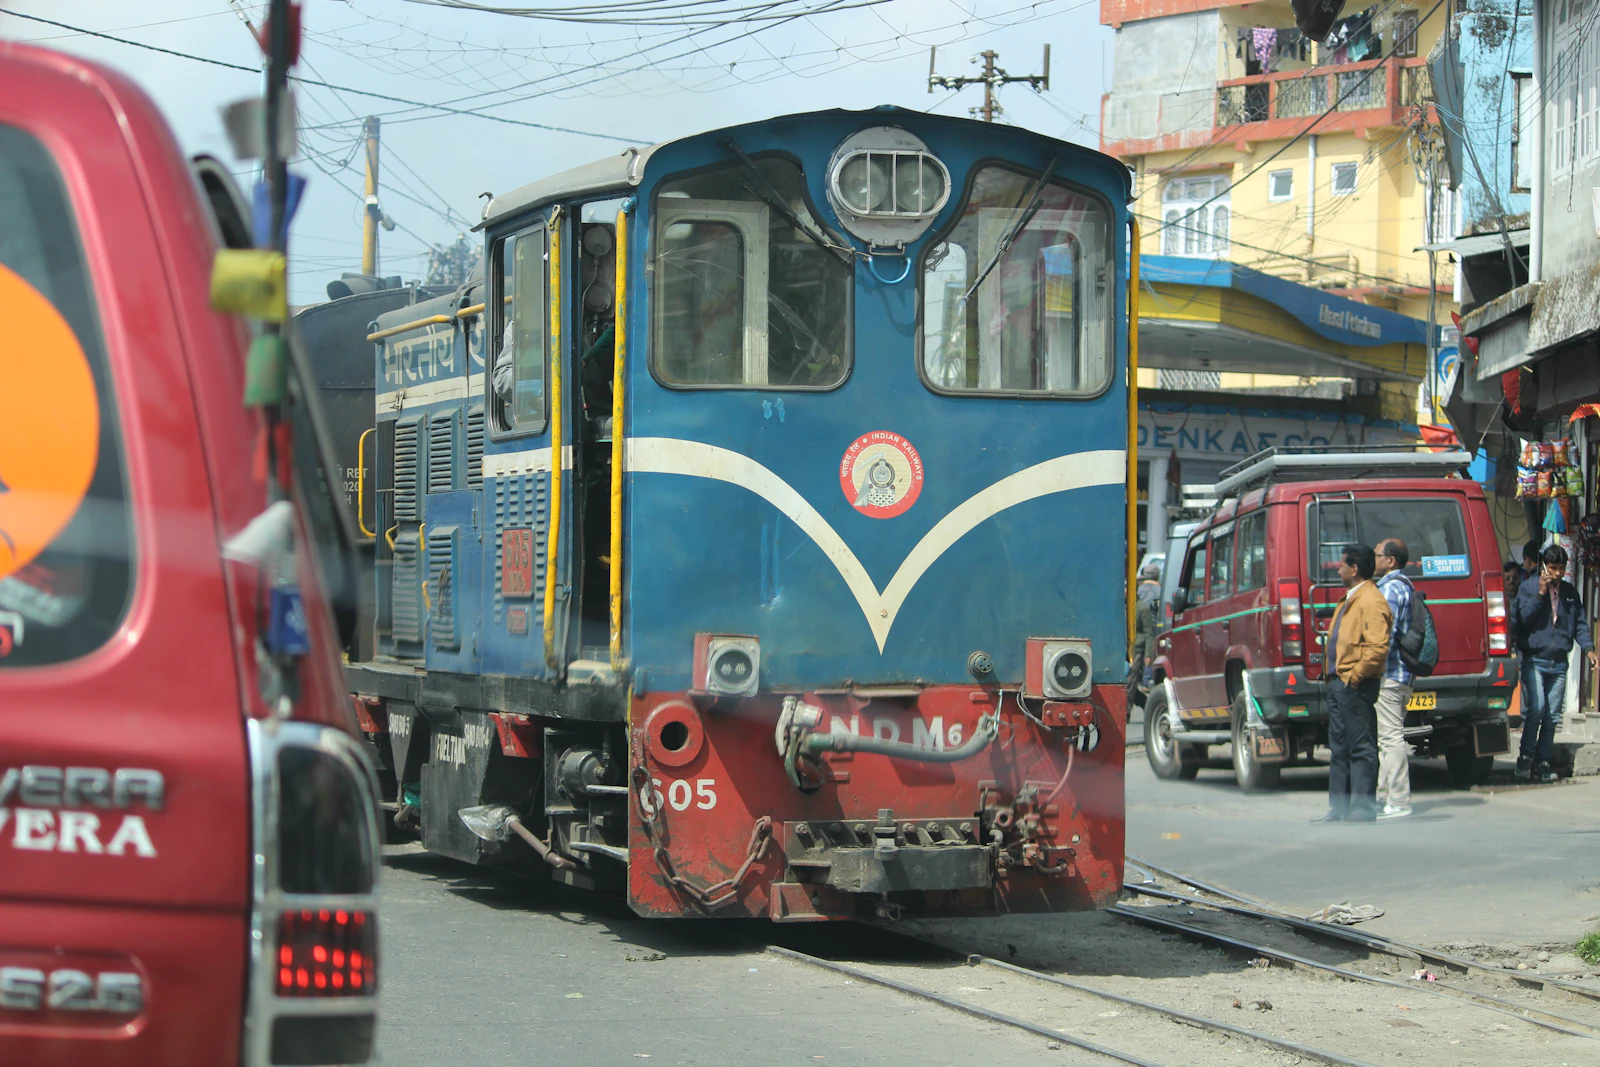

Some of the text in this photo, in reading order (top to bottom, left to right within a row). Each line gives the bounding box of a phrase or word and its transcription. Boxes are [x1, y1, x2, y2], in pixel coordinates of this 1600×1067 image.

[385, 324, 455, 385] भारतीय
[871, 432, 923, 480] INDIAN RAILWAYS
[640, 778, 717, 813] 605
